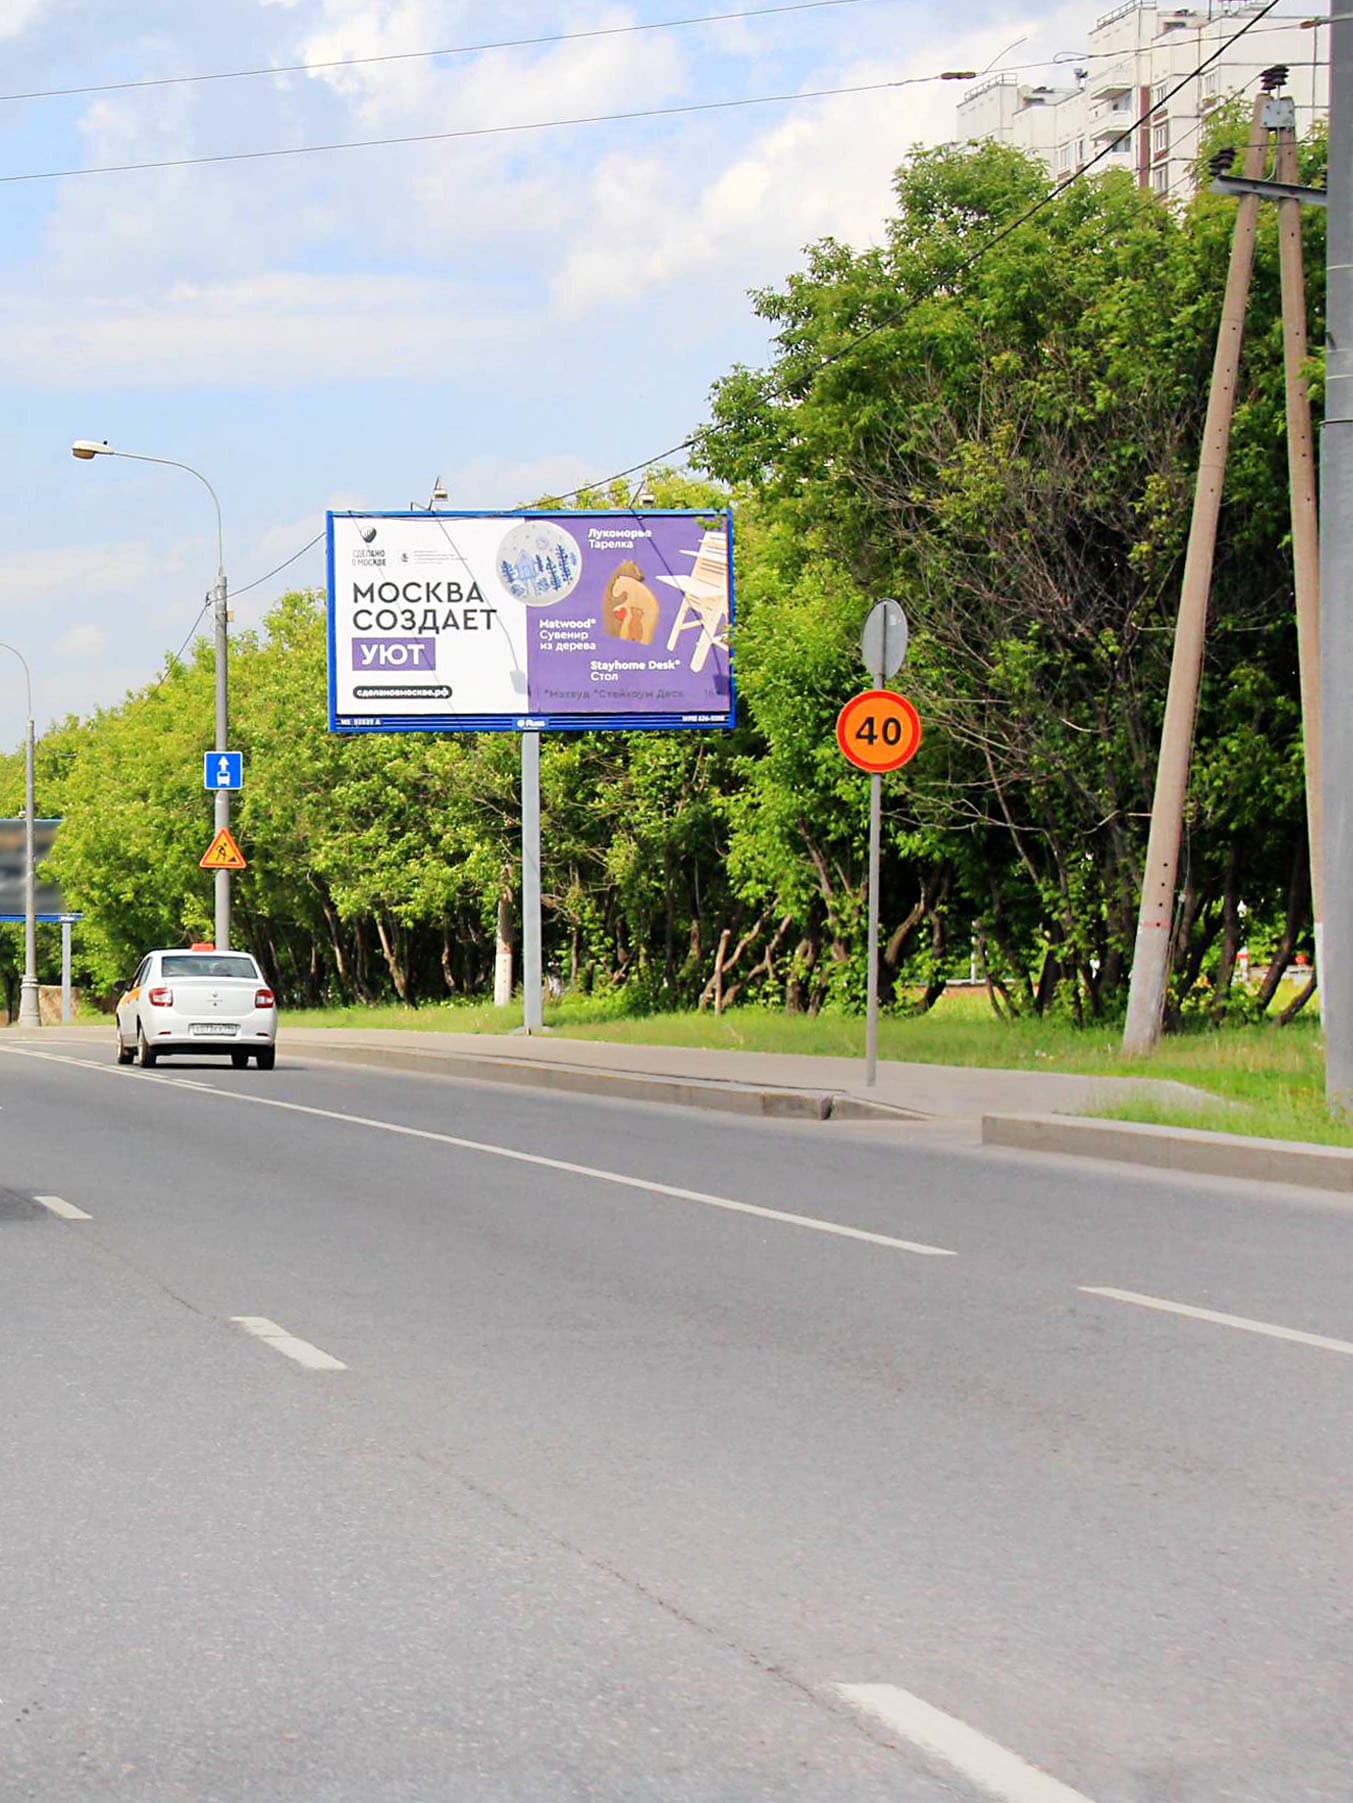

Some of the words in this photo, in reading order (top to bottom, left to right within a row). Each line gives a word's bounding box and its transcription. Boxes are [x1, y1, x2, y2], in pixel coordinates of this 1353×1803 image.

[588, 528, 652, 540] Лукоморье
[589, 540, 633, 550] Тарелка
[353, 582, 485, 603] МОСКВА
[353, 609, 497, 634] СОЗДАЕТ
[539, 630, 589, 641] Сувенир
[540, 642, 553, 650] из
[555, 642, 596, 652] дерева
[360, 644, 425, 665] УЮТ
[590, 660, 645, 672] Stayhome
[590, 672, 618, 681] Стол
[356, 687, 449, 697] сделановмоскве.рф
[855, 716, 902, 746] 40
